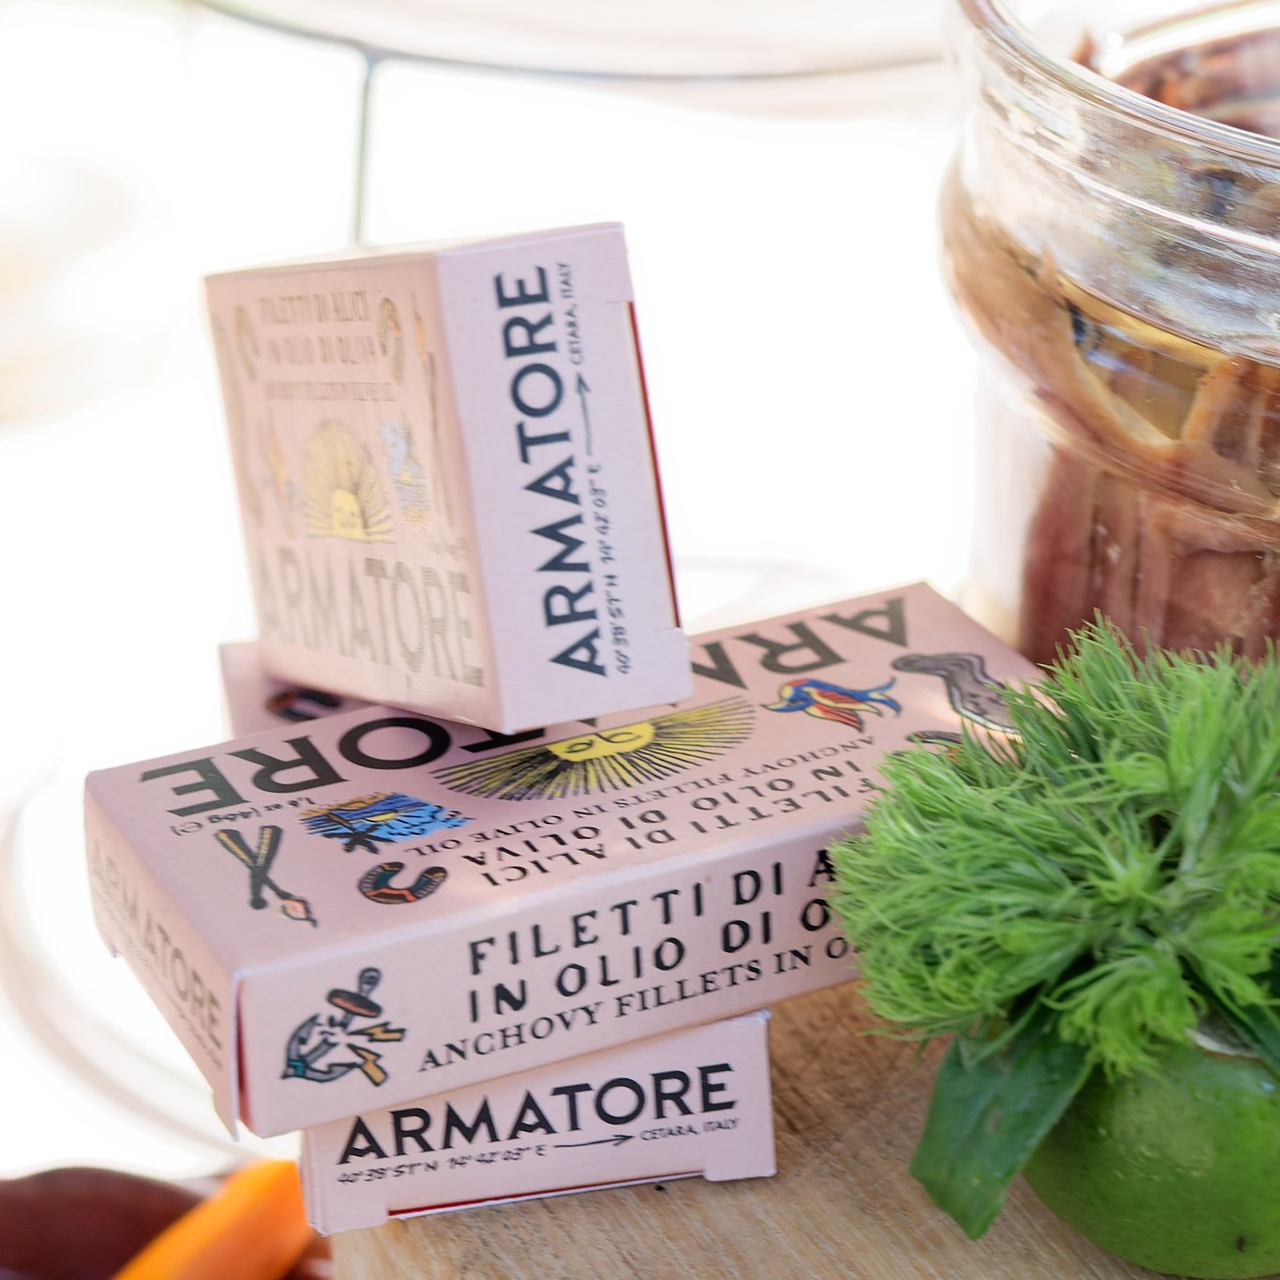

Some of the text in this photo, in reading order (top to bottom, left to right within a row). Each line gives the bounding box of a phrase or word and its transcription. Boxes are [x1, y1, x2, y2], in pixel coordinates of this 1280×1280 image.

[557, 261, 574, 299] ITALY
[494, 265, 607, 678] ARMATORE
[404, 736, 874, 857] ANCHOVY FILLETS IN OLIVE OIL
[461, 760, 862, 866] IN OLIO DI OLIVA
[480, 777, 880, 887] FILETTI DI ALICI
[469, 882, 703, 975] FILETTI
[733, 862, 783, 905] DI
[469, 978, 528, 1022] IN
[555, 936, 686, 998] OLIO
[722, 910, 771, 954] DI
[419, 1001, 604, 1072] ANCHOVY
[615, 958, 761, 1018] FILLETS
[773, 946, 813, 974] IN
[337, 1063, 739, 1165] ARMATORE
[702, 1117, 740, 1133] ITALY
